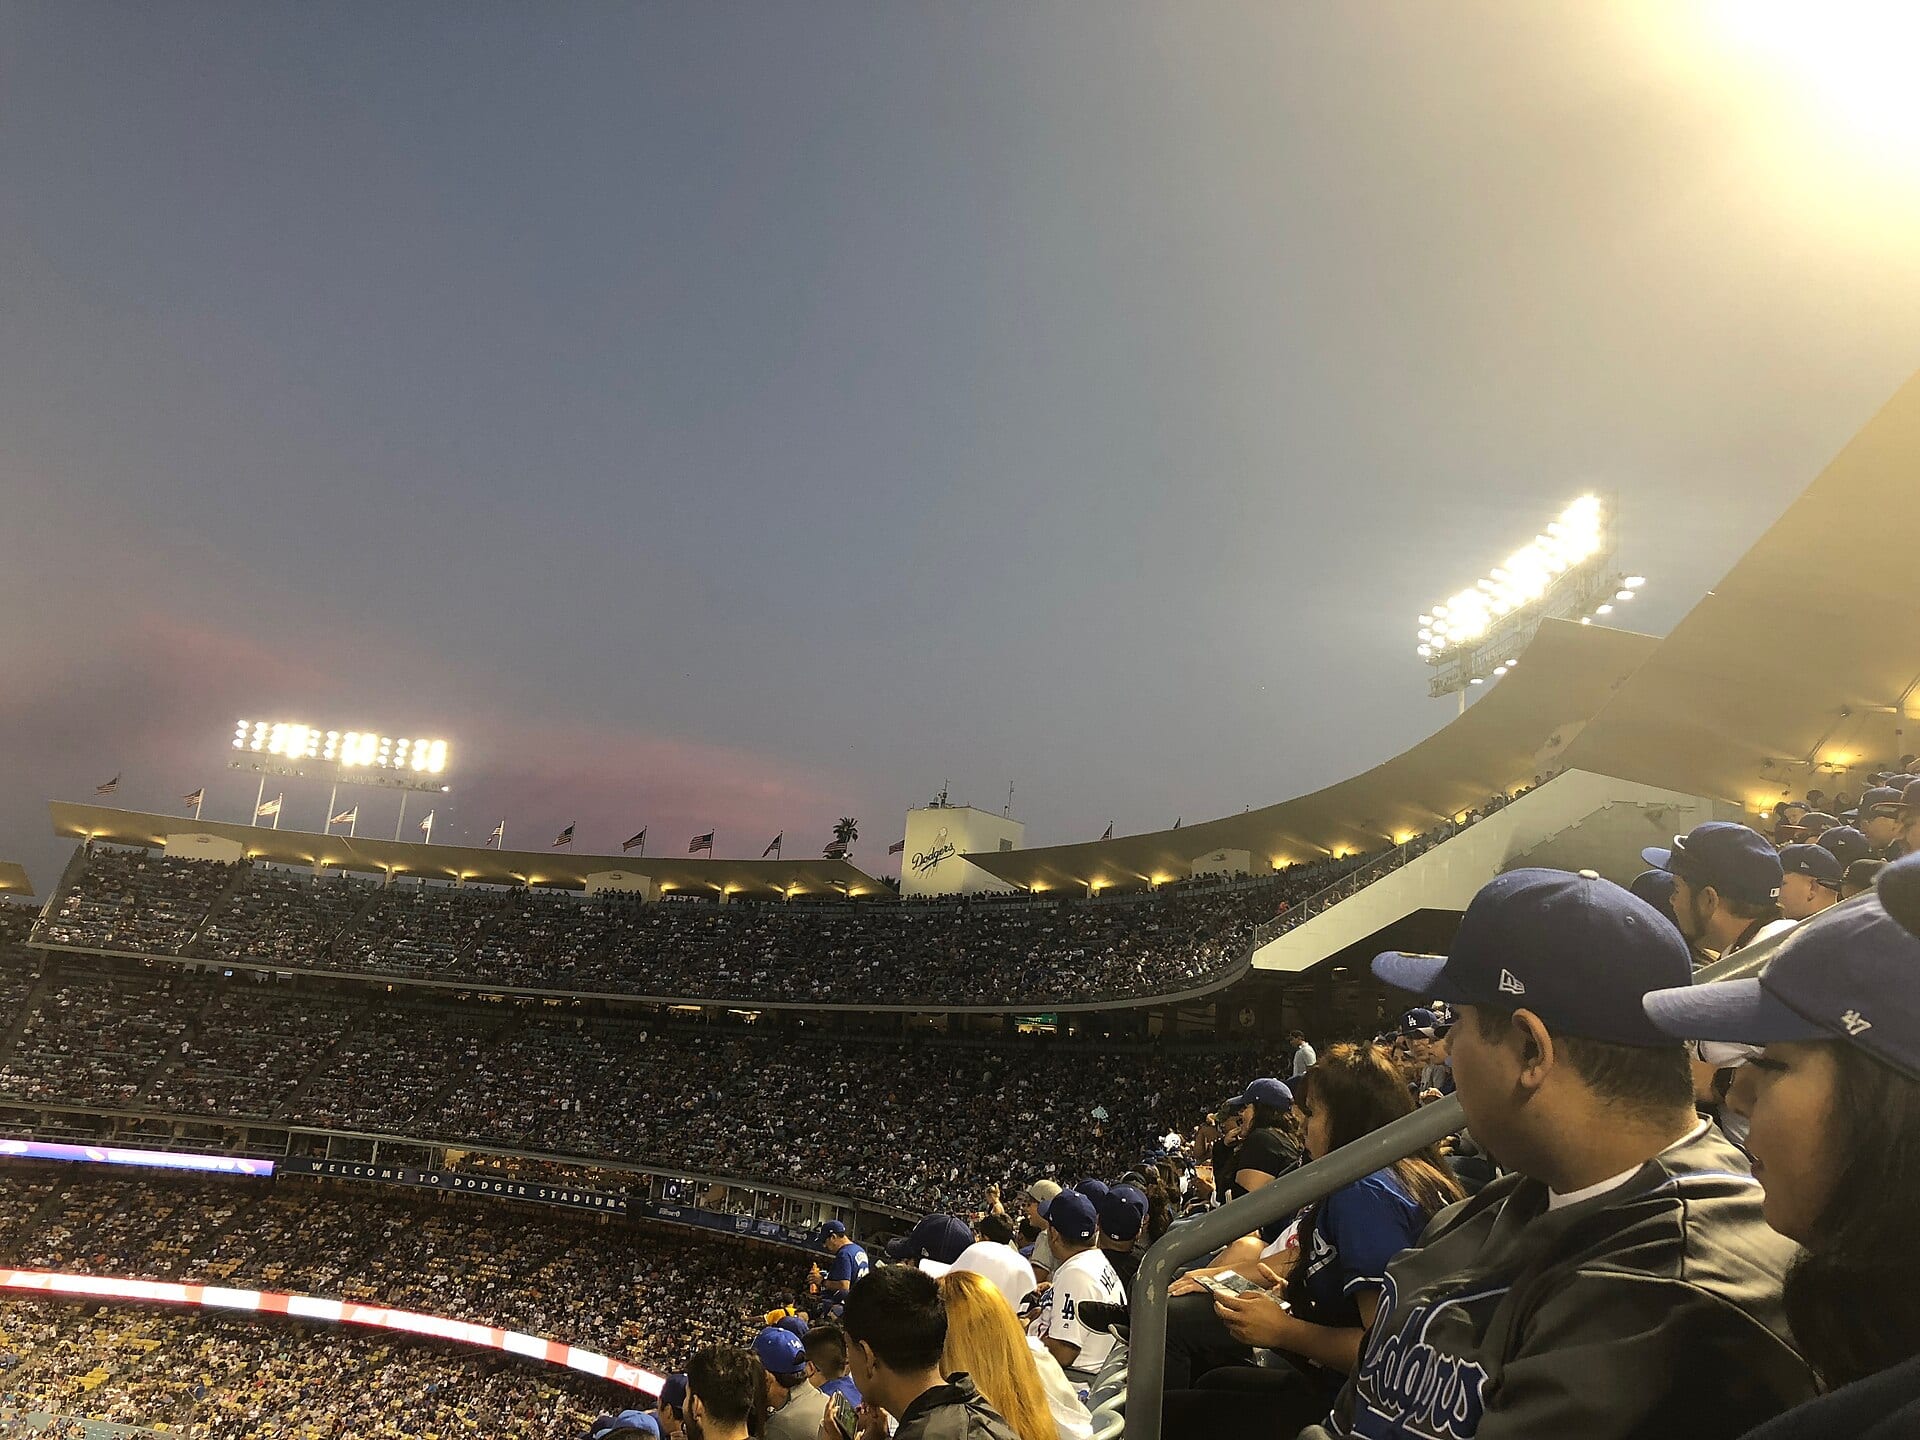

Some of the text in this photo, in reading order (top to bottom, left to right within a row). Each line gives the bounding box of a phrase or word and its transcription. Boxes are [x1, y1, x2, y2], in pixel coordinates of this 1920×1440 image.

[911, 843, 956, 872] Dodgers
[1408, 1015, 1417, 1026] LA
[312, 1162, 615, 1208] WELCOME TO DODGER STADIUM
[1061, 1292, 1075, 1321] LA
